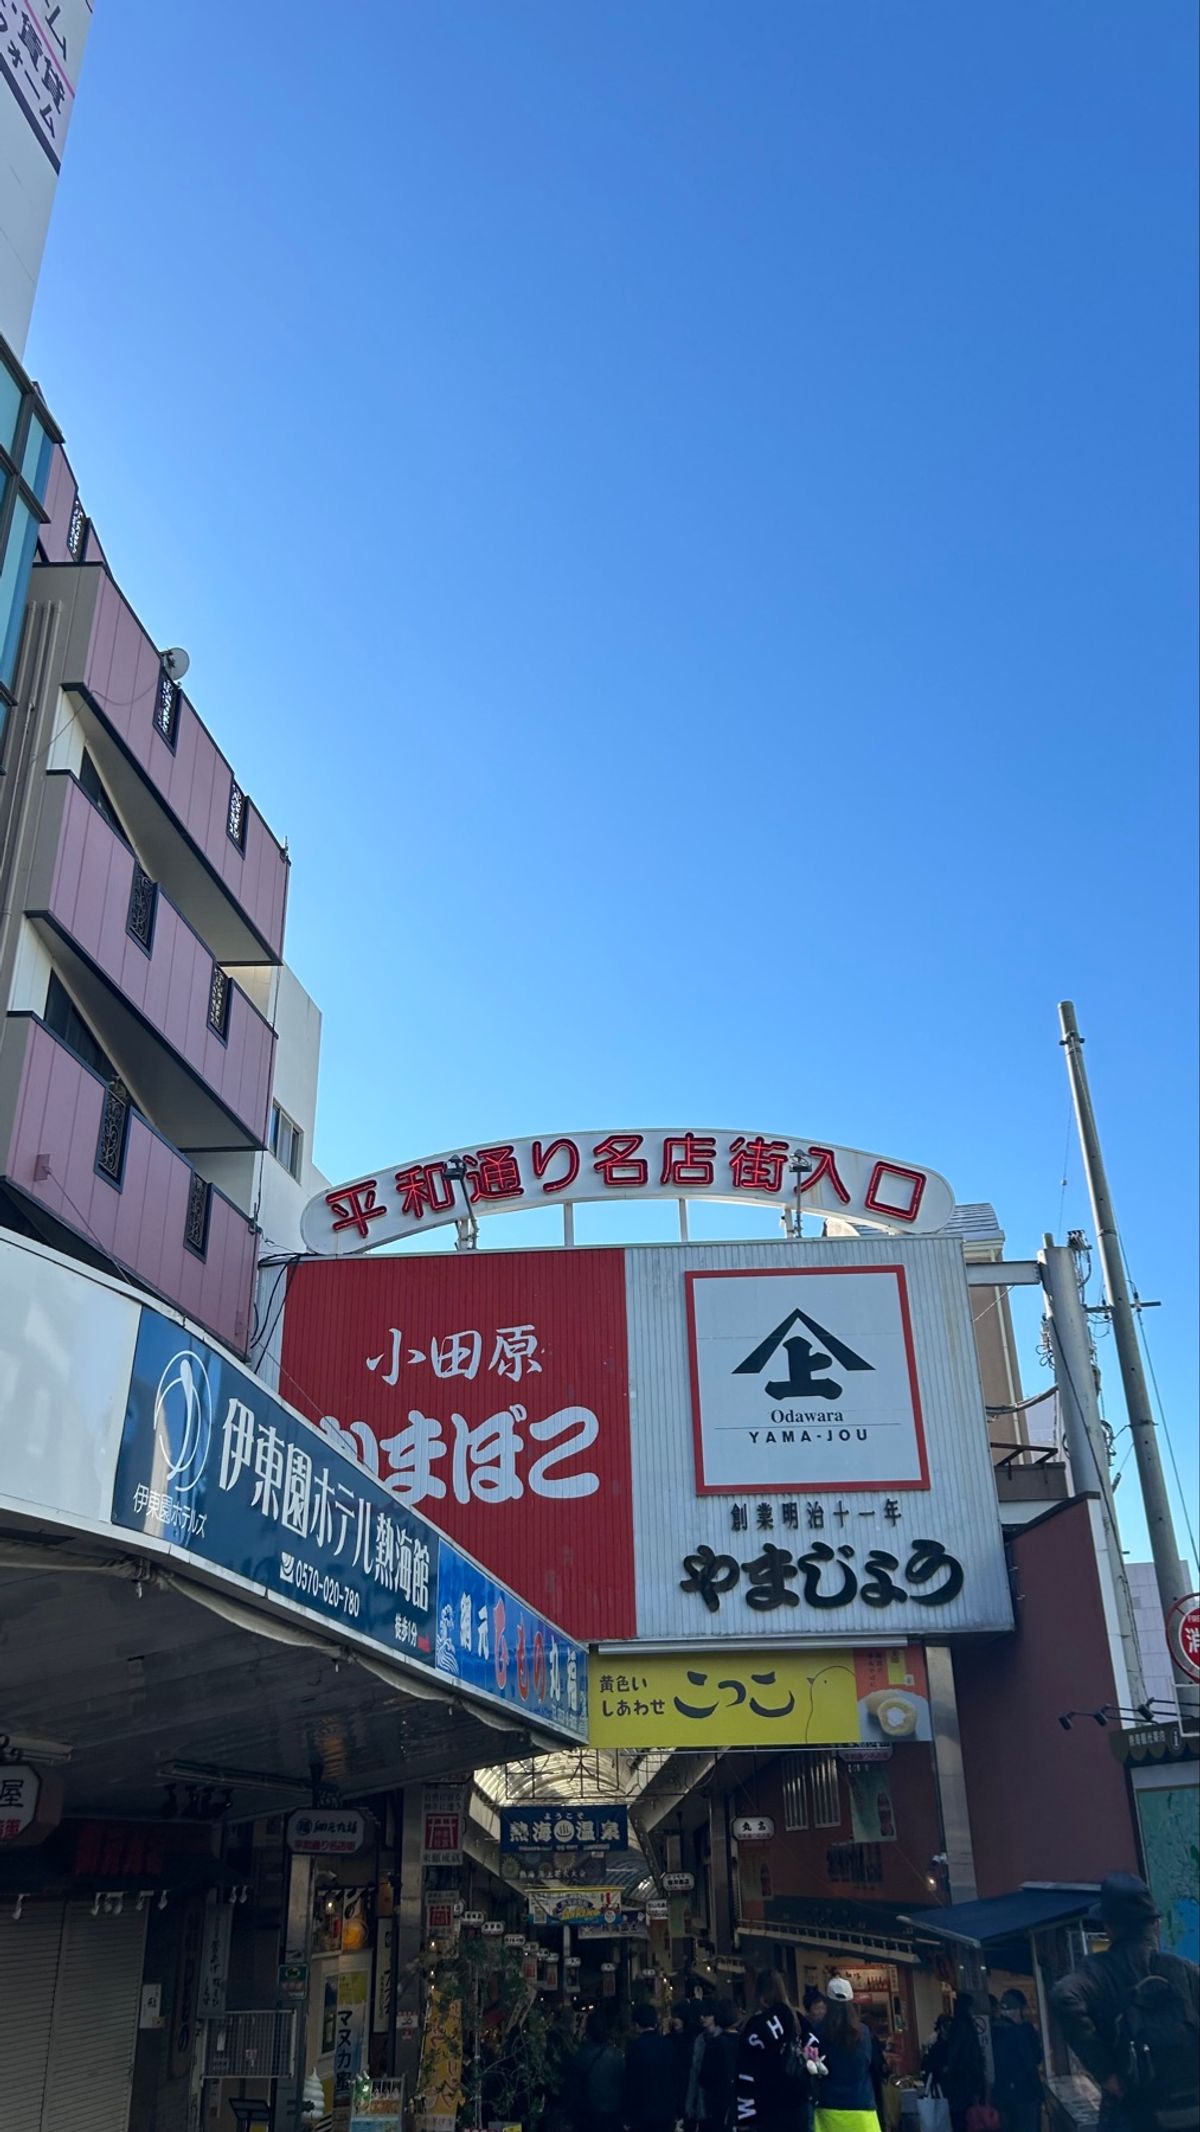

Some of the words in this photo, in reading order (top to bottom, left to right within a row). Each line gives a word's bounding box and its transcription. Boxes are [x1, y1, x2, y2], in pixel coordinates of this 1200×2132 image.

[326, 1132, 927, 1238] 平和通り名店街入口
[366, 1324, 545, 1386] 小田原
[749, 1429, 869, 1443] YAMA-JOU
[771, 1409, 843, 1424] Odawara
[133, 1482, 207, 1539] 伊東園ホテルズ
[731, 1498, 902, 1531] 創業明治十一年
[296, 1560, 360, 1617] 0570-020-780
[681, 1539, 964, 1613] やまじょう
[600, 1675, 647, 1693] 黄色い
[673, 1670, 795, 1719] こっこ
[602, 1698, 665, 1717] しあわせ
[0, 1780, 24, 1807] 屋
[543, 1812, 584, 1821] ようこそ
[336, 2010, 353, 2092] マヌカ蜜
